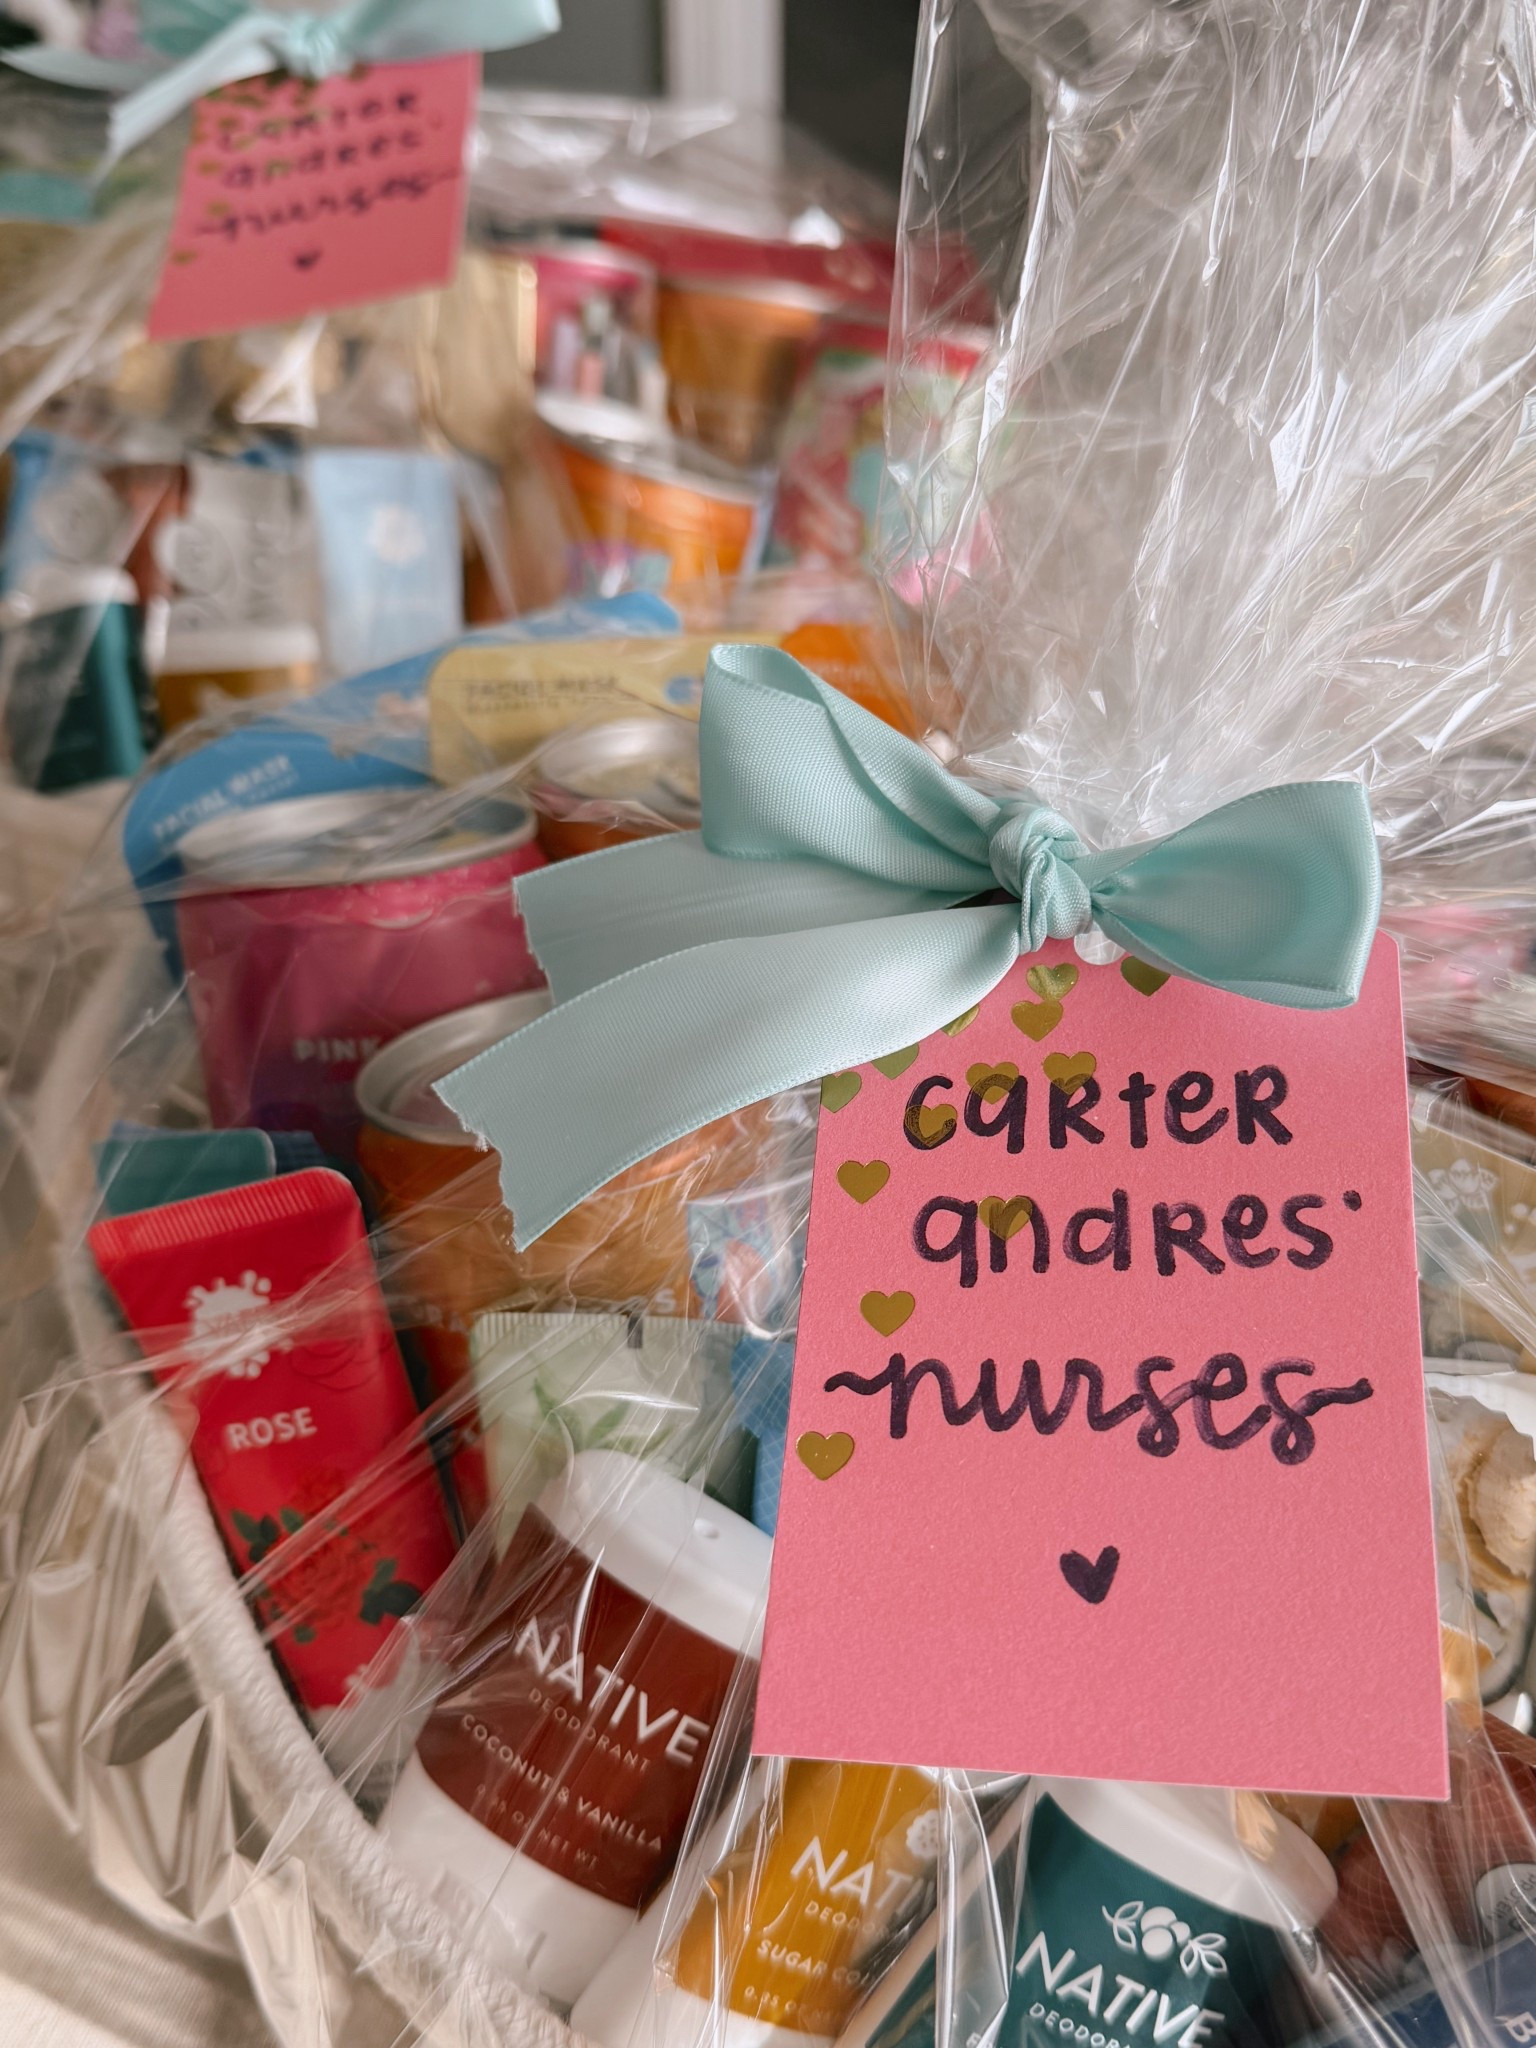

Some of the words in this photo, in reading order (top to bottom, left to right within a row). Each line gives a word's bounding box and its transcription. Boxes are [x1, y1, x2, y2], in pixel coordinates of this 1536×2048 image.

[225, 1406, 318, 1449] ROSE
[824, 1352, 1374, 1465] nurses
[514, 1614, 711, 1766] NATIVE
[528, 1687, 651, 1772] DEODORANT
[461, 1713, 555, 1790] COCONUT
[557, 1786, 571, 1805] &
[576, 1796, 662, 1852] VANILLA
[757, 1938, 828, 1980] SUGAR
[1015, 1931, 1226, 2048] NATIVE
[1029, 2001, 1132, 2048] DEODOR
